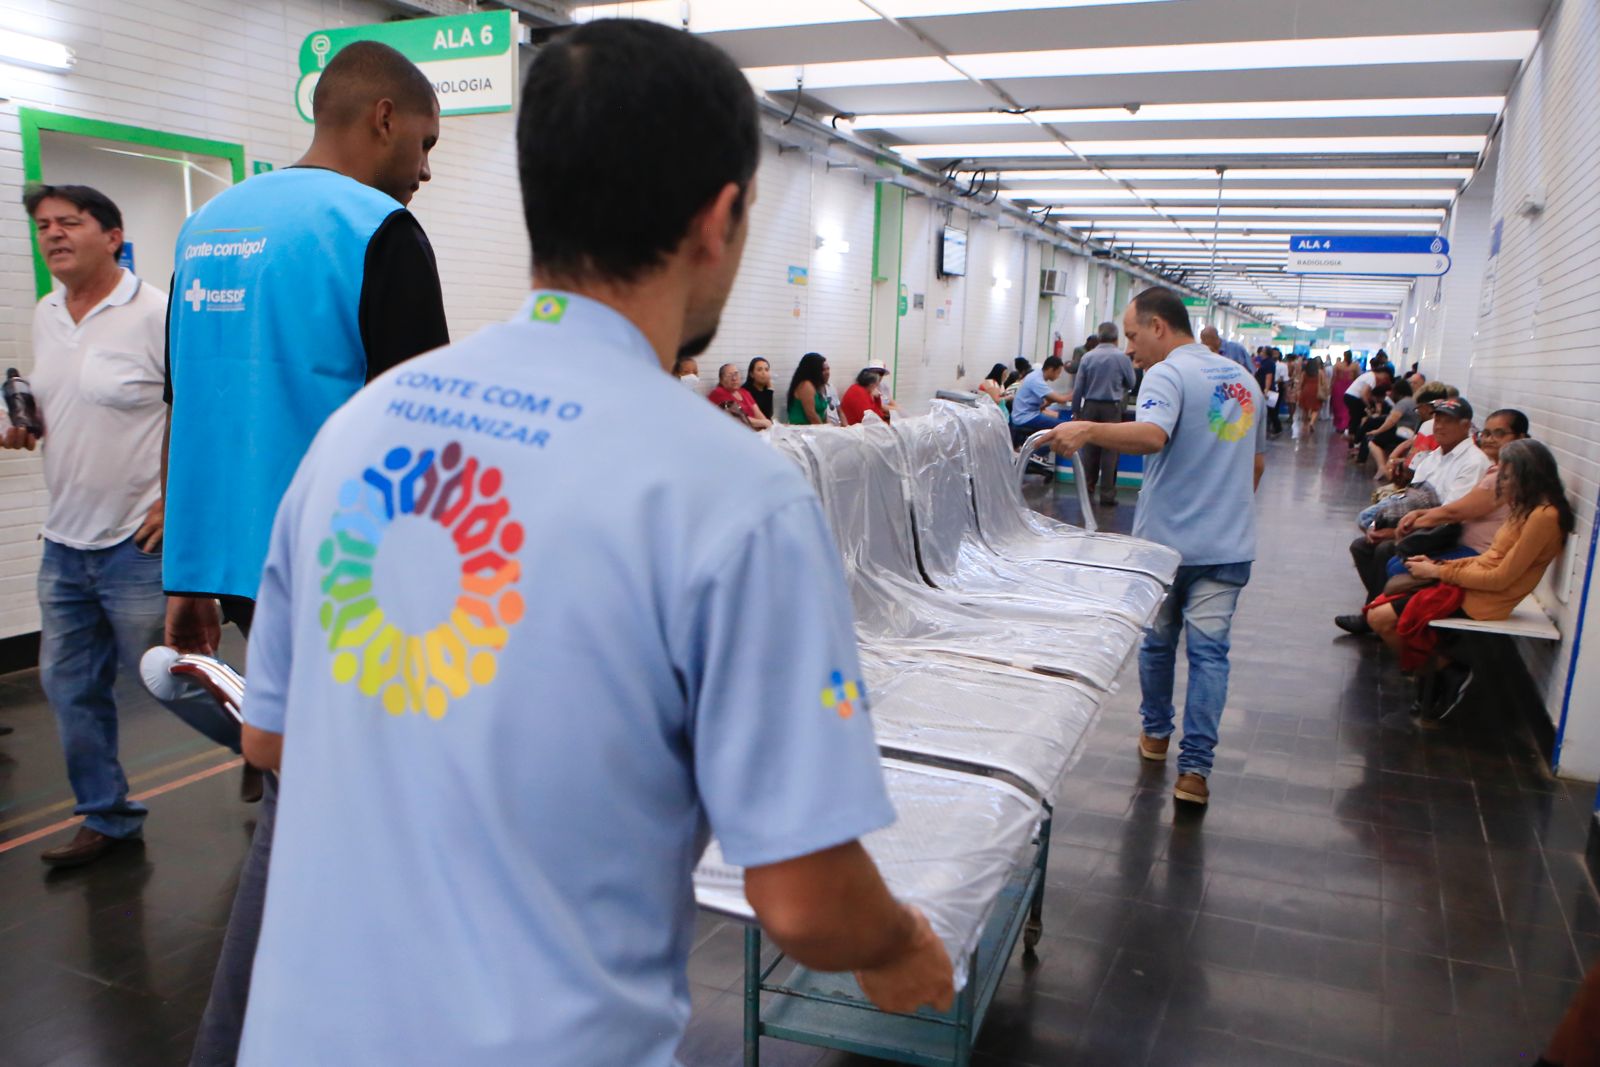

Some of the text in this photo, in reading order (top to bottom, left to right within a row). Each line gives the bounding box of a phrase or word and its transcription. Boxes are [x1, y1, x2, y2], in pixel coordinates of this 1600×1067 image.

[434, 25, 493, 49] ALA 6
[431, 78, 492, 93] NOLOGIA
[214, 238, 266, 258] comigo!
[1298, 240, 1331, 249] ALA 4
[396, 372, 583, 422] CONTE COM O
[387, 399, 551, 447] HUMANIZAR
